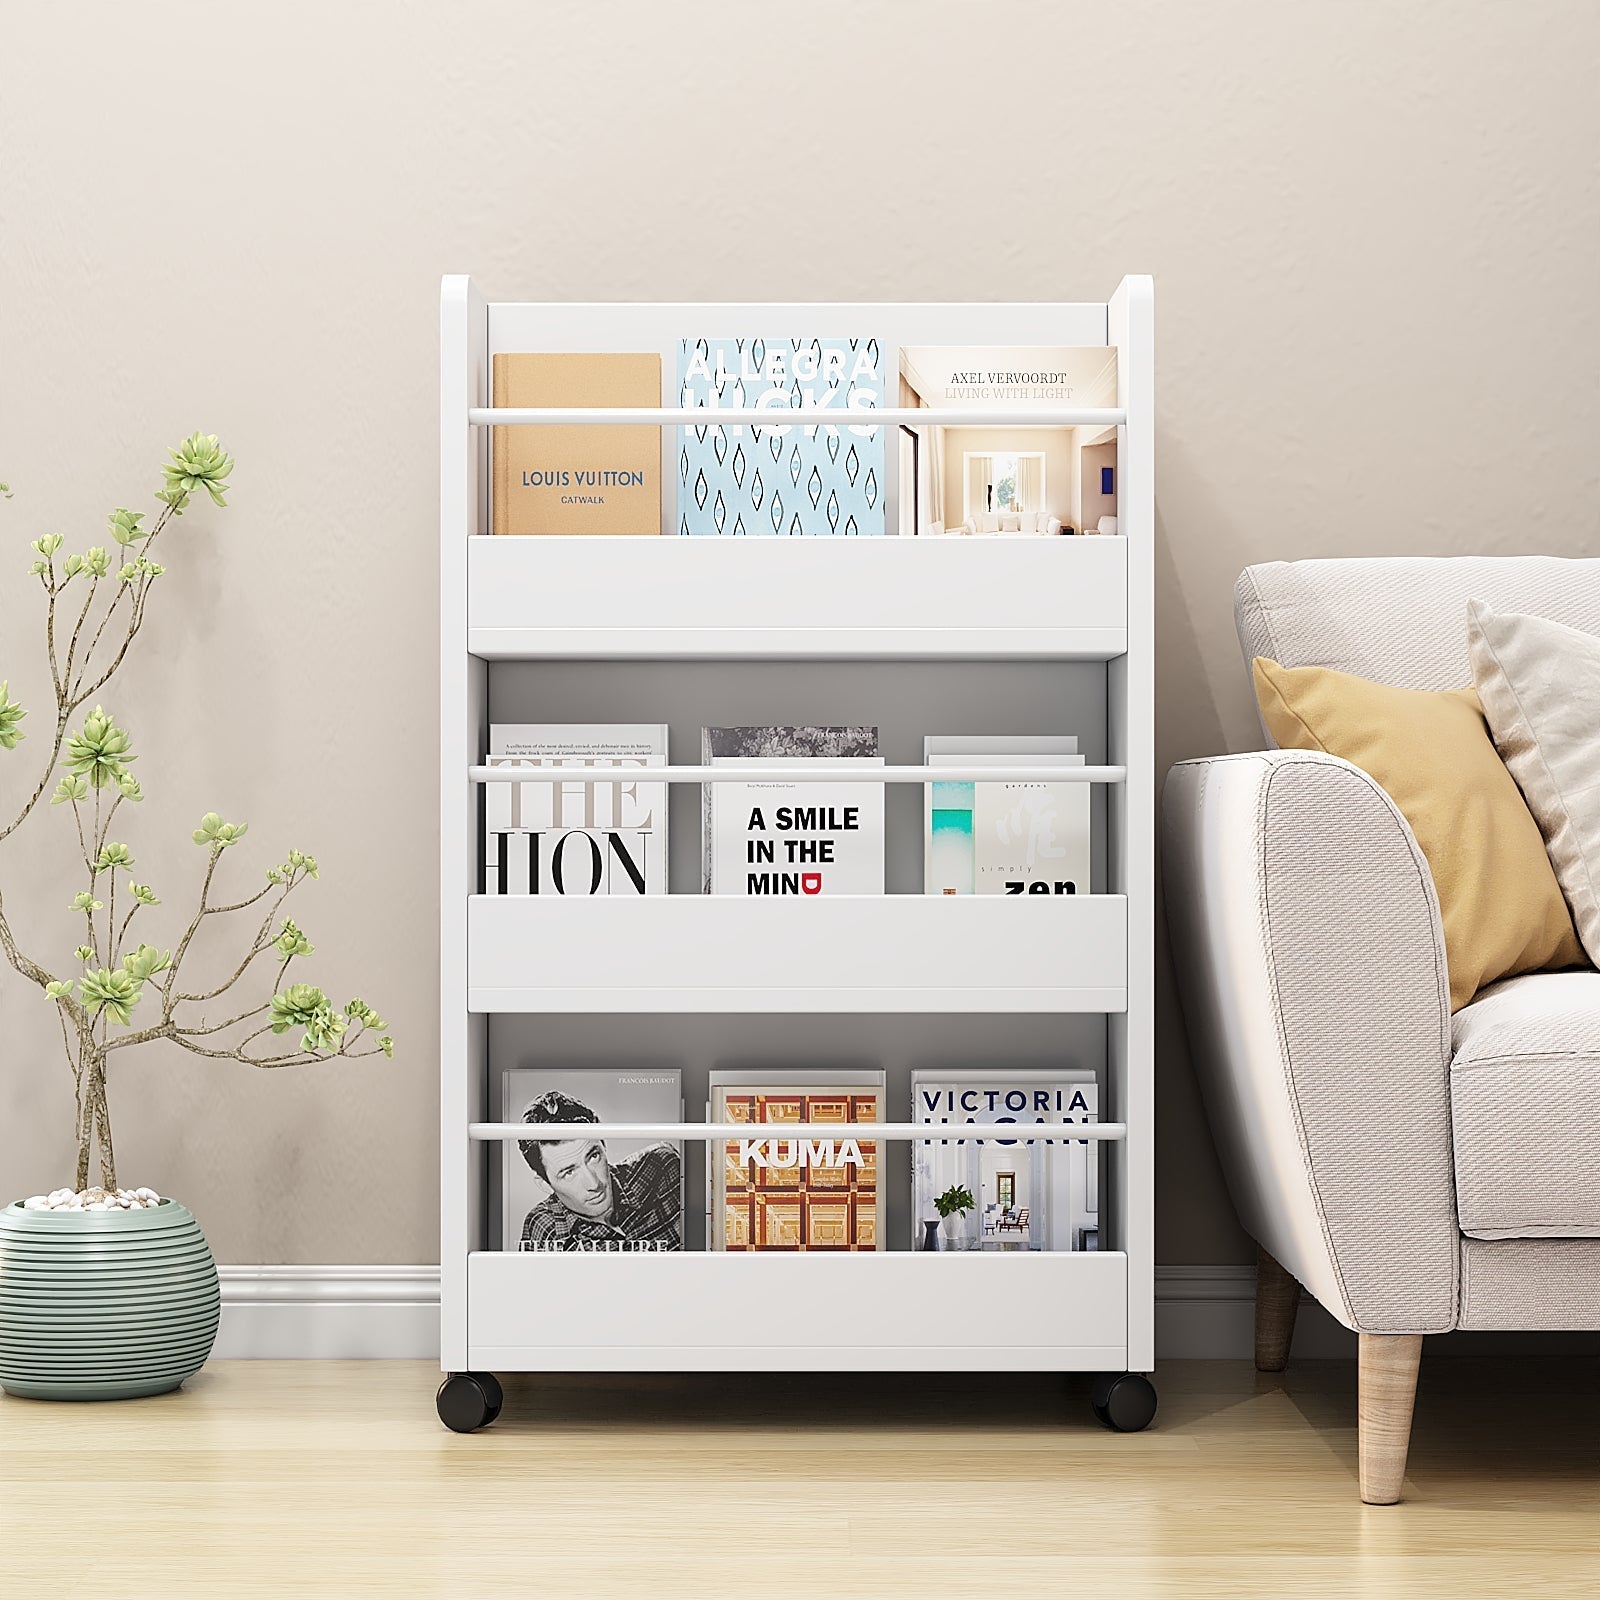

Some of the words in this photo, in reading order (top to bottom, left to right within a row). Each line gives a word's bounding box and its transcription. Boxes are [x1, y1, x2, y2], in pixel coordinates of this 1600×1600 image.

[685, 349, 878, 382] ALLEGRA
[951, 373, 985, 384] AXEL
[989, 373, 1067, 384] VERVOORDT
[945, 388, 990, 399] LIVING
[993, 388, 1028, 399] WITH
[1033, 388, 1073, 399] LIGHT
[685, 388, 879, 436] HICKS
[522, 471, 570, 486] LOUIS
[574, 471, 643, 486] VUITTON
[561, 496, 605, 504] CATWALK
[490, 759, 652, 829] THE
[747, 807, 766, 831] A
[775, 807, 859, 831] SMILE
[747, 840, 775, 863] IN
[784, 840, 834, 863] THE
[981, 865, 1032, 873] simply
[747, 873, 822, 894] MIND
[1005, 881, 1076, 895] zen
[923, 1090, 1089, 1112] VICTORIA
[739, 1139, 866, 1168] KUMA
